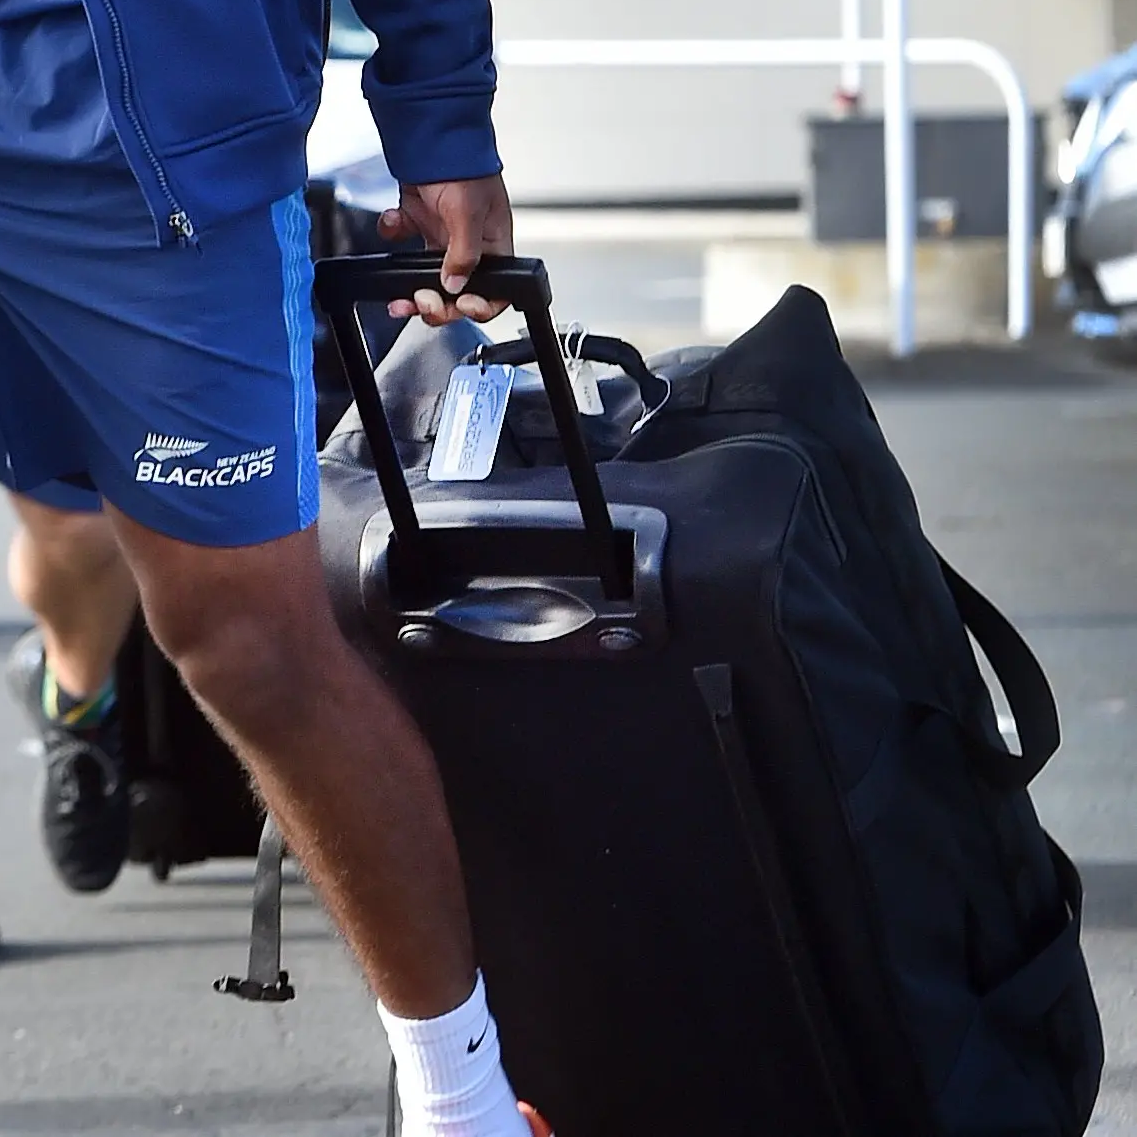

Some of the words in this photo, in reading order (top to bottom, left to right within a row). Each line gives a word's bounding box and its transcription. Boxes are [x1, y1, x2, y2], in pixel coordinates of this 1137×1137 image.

[217, 456, 239, 468] NEW
[239, 445, 276, 464] ZEALAND
[135, 456, 276, 487] BLACKCAPS
